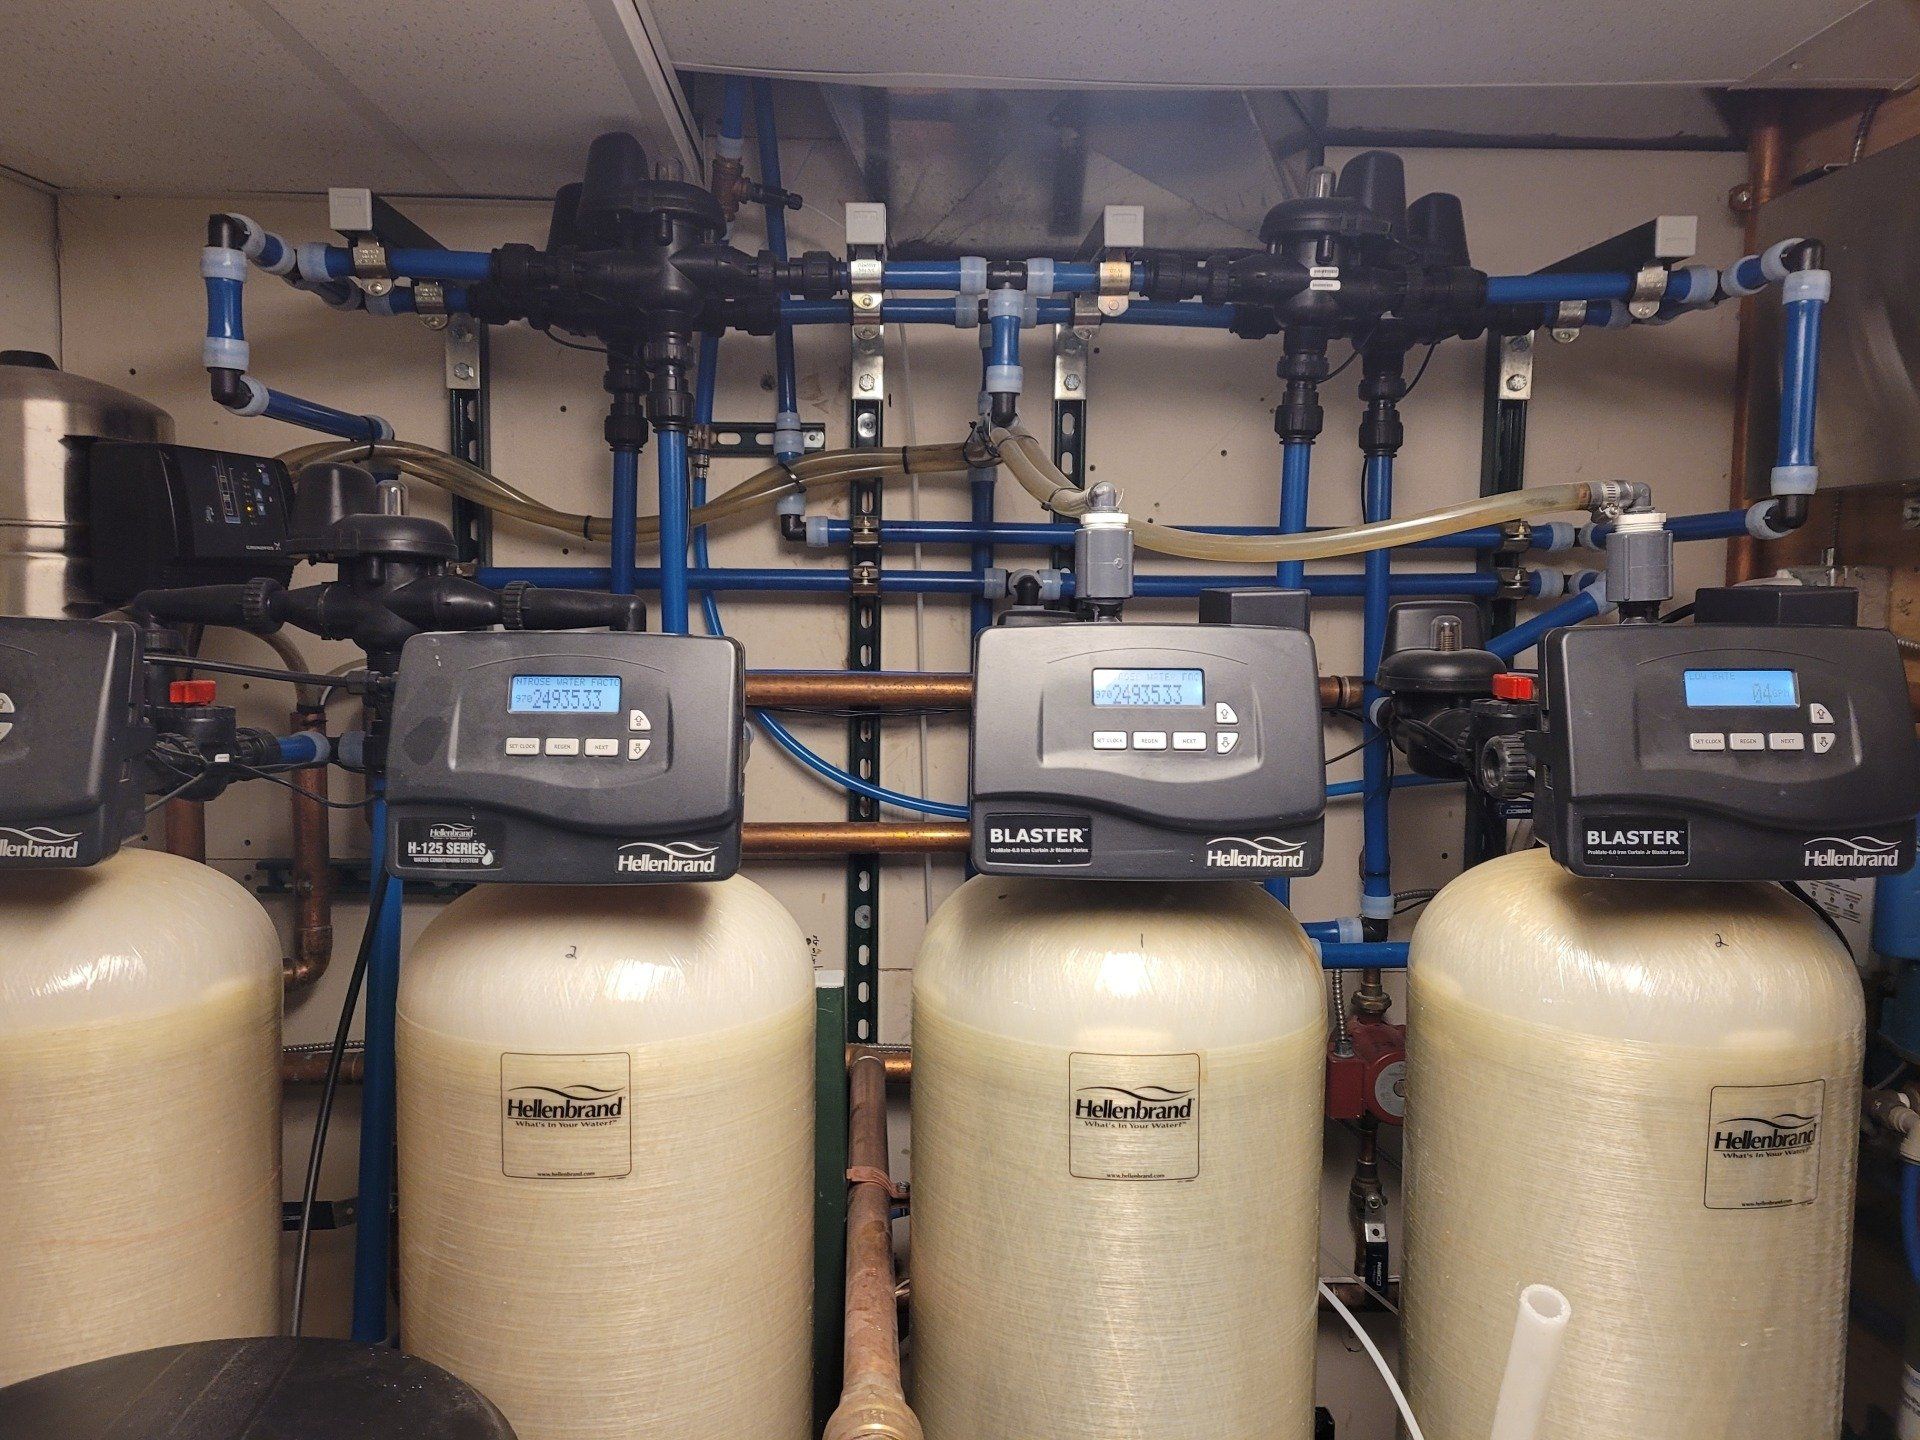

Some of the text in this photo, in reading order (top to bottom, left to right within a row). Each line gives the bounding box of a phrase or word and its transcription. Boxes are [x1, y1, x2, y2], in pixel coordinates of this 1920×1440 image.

[556, 677, 586, 687] WATER
[1713, 672, 1736, 680] RATE
[532, 688, 602, 710] 2493533
[1113, 684, 1182, 705] 2493533
[429, 828, 474, 838] Hellenbrand
[407, 841, 486, 855] H-125 SERIES
[617, 853, 716, 873] Hellenbrand
[1206, 849, 1305, 868] Hellenbrand
[1804, 848, 1899, 867] Hellenbrand
[1715, 933, 1729, 947] 2
[565, 945, 577, 960] 2
[507, 1096, 623, 1118] Hellenbrand
[1075, 1098, 1192, 1119] Hellenbrand
[515, 1120, 545, 1128] What's
[1713, 1123, 1817, 1149] Hellenbrand
[1741, 1199, 1793, 1207] www.hellenbrand.com
